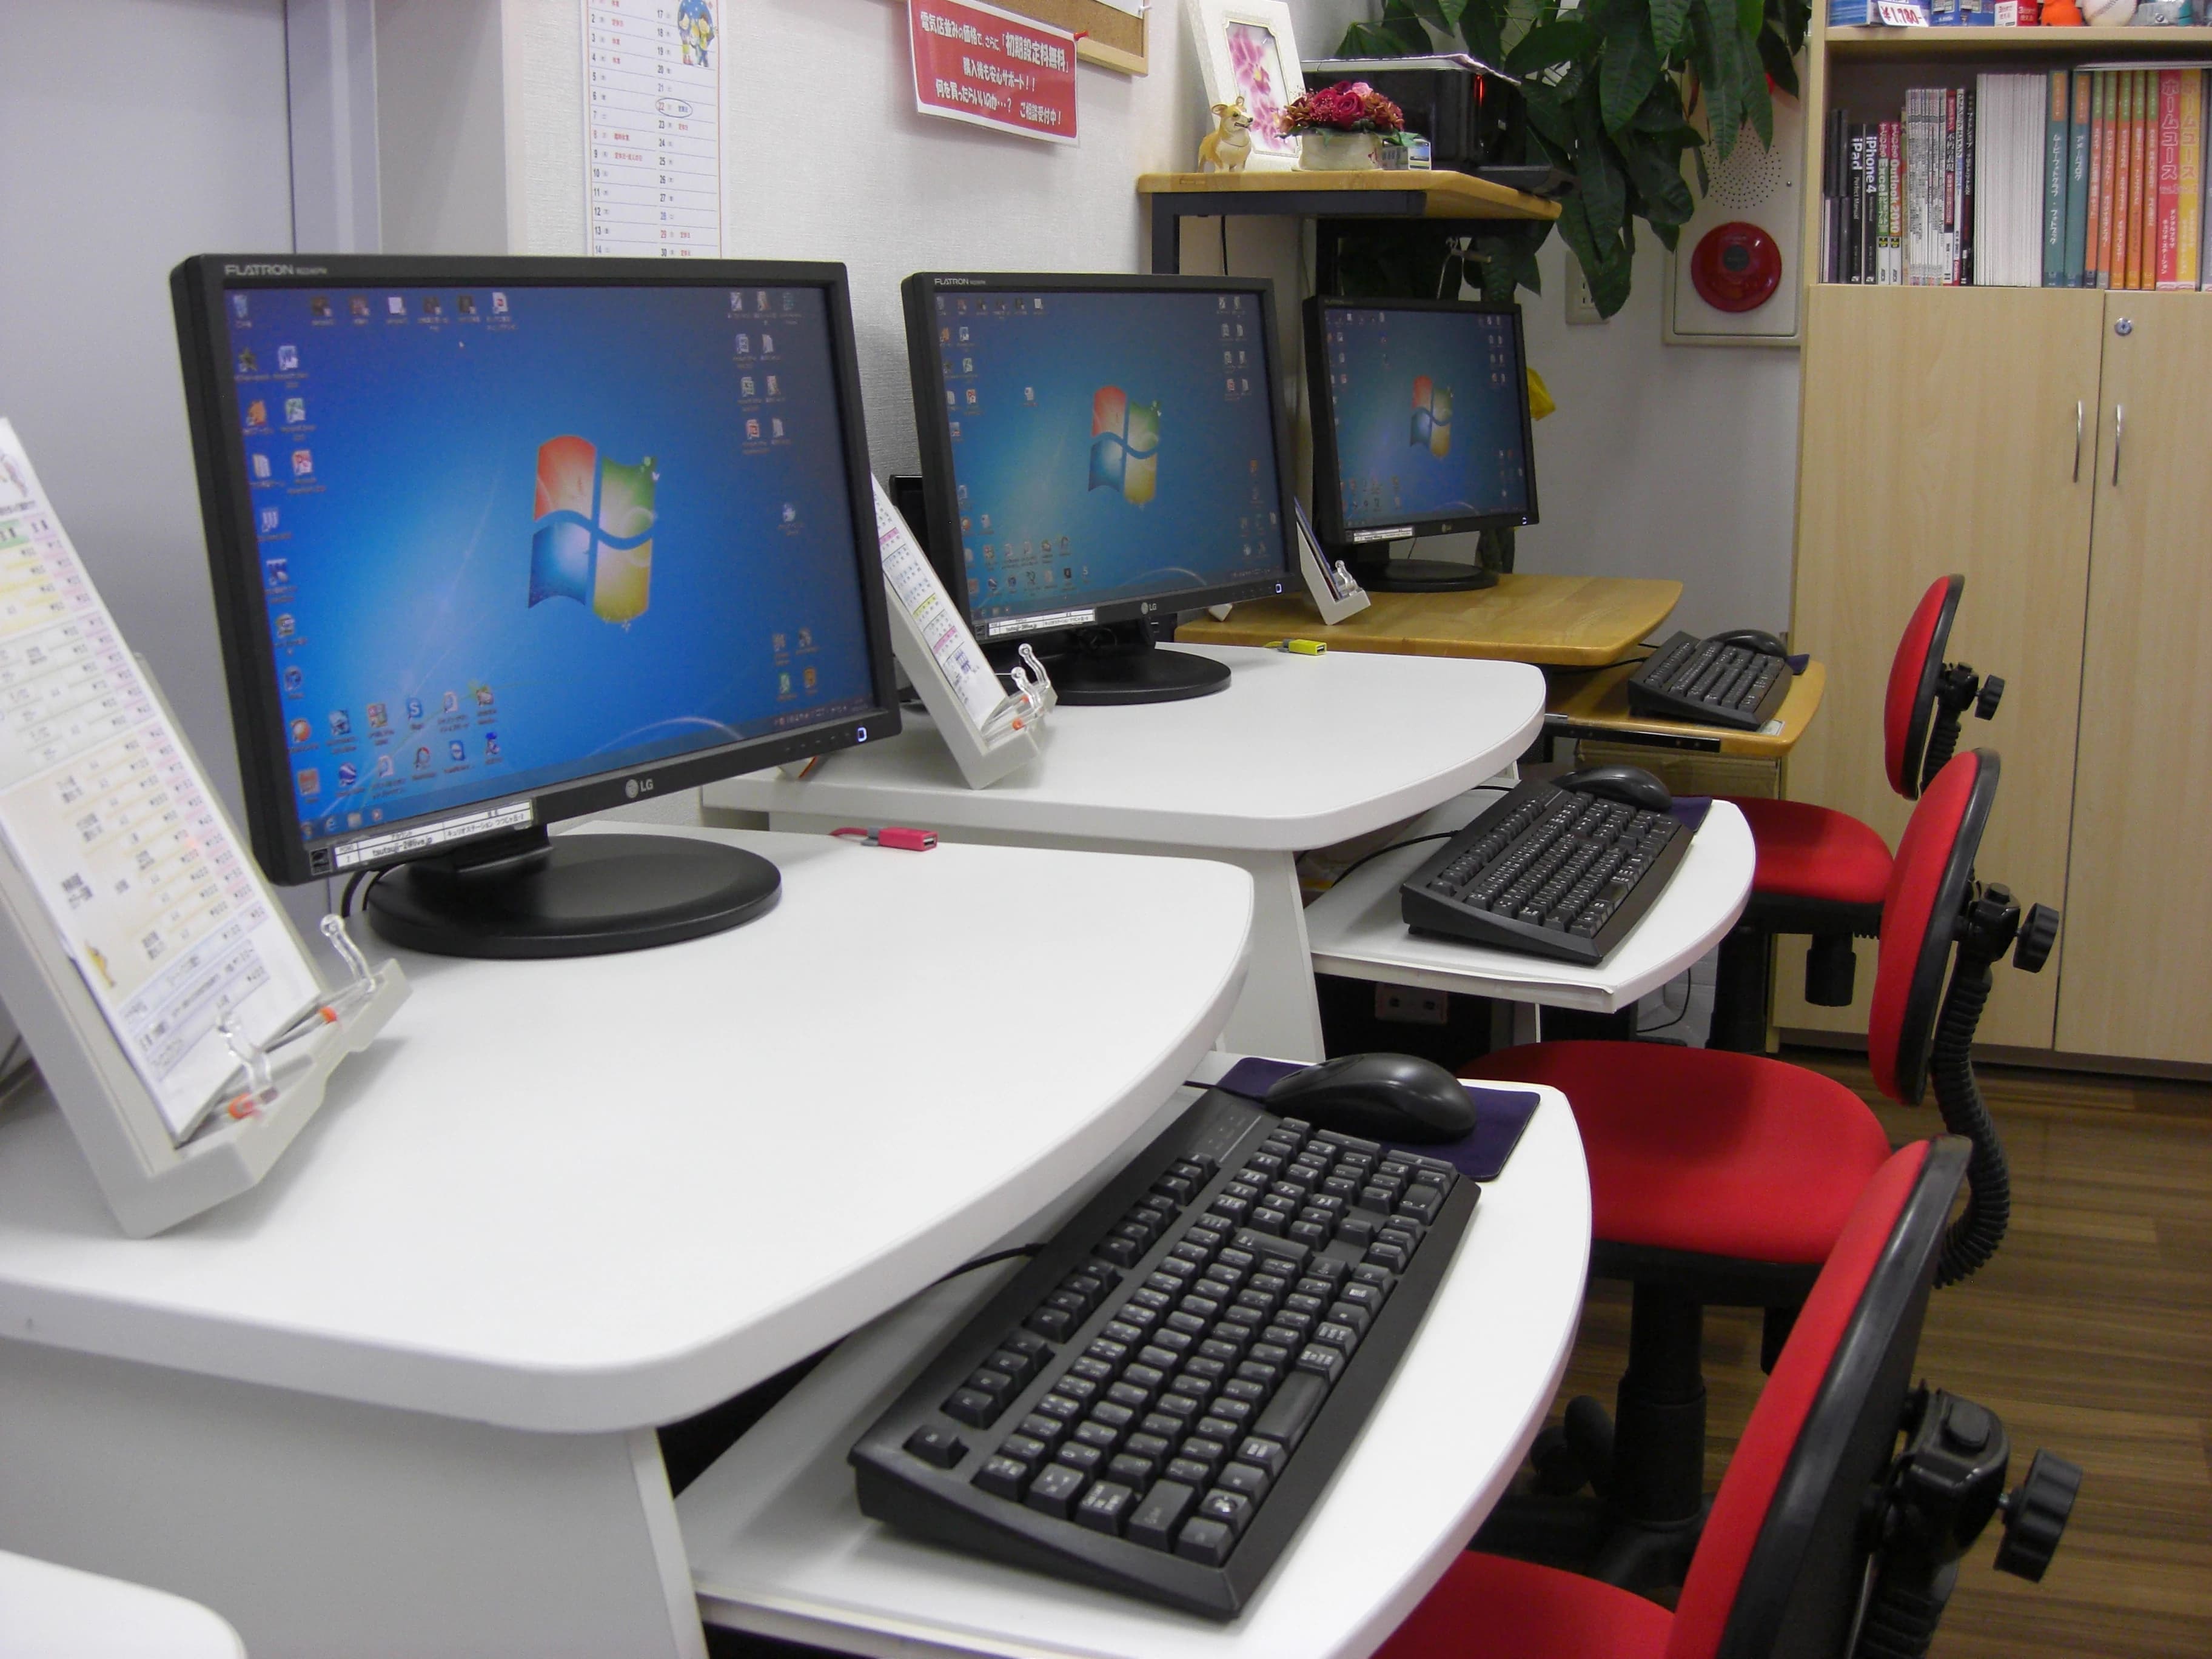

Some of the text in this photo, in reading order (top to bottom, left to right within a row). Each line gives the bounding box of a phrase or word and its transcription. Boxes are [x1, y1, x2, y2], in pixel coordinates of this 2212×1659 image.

[591, 14, 595, 23] 2
[657, 9, 663, 19] 17
[592, 33, 595, 42] 3
[657, 28, 664, 38] 18
[657, 46, 664, 56] 19
[657, 64, 665, 74] 20
[592, 72, 597, 81] 5
[592, 92, 597, 101] 6
[659, 101, 665, 110] 22
[659, 120, 665, 129] 23
[2162, 79, 2179, 181] ホームコース
[659, 138, 666, 148] 24
[594, 149, 598, 158] 9
[1851, 138, 1863, 170] iPad
[659, 156, 666, 166] 25
[1865, 136, 1877, 193] iPhone 4
[594, 168, 600, 178] 10
[1878, 158, 1889, 196] Excel
[660, 175, 666, 184] 26
[1890, 159, 1900, 204] Outlook
[594, 187, 600, 197] 11
[660, 193, 666, 203] 27
[594, 207, 601, 216] 12
[1890, 204, 1901, 233] 2010
[594, 226, 602, 235] 13
[660, 230, 666, 238] 29
[224, 264, 294, 276] FLATRON
[640, 779, 654, 793] LG
